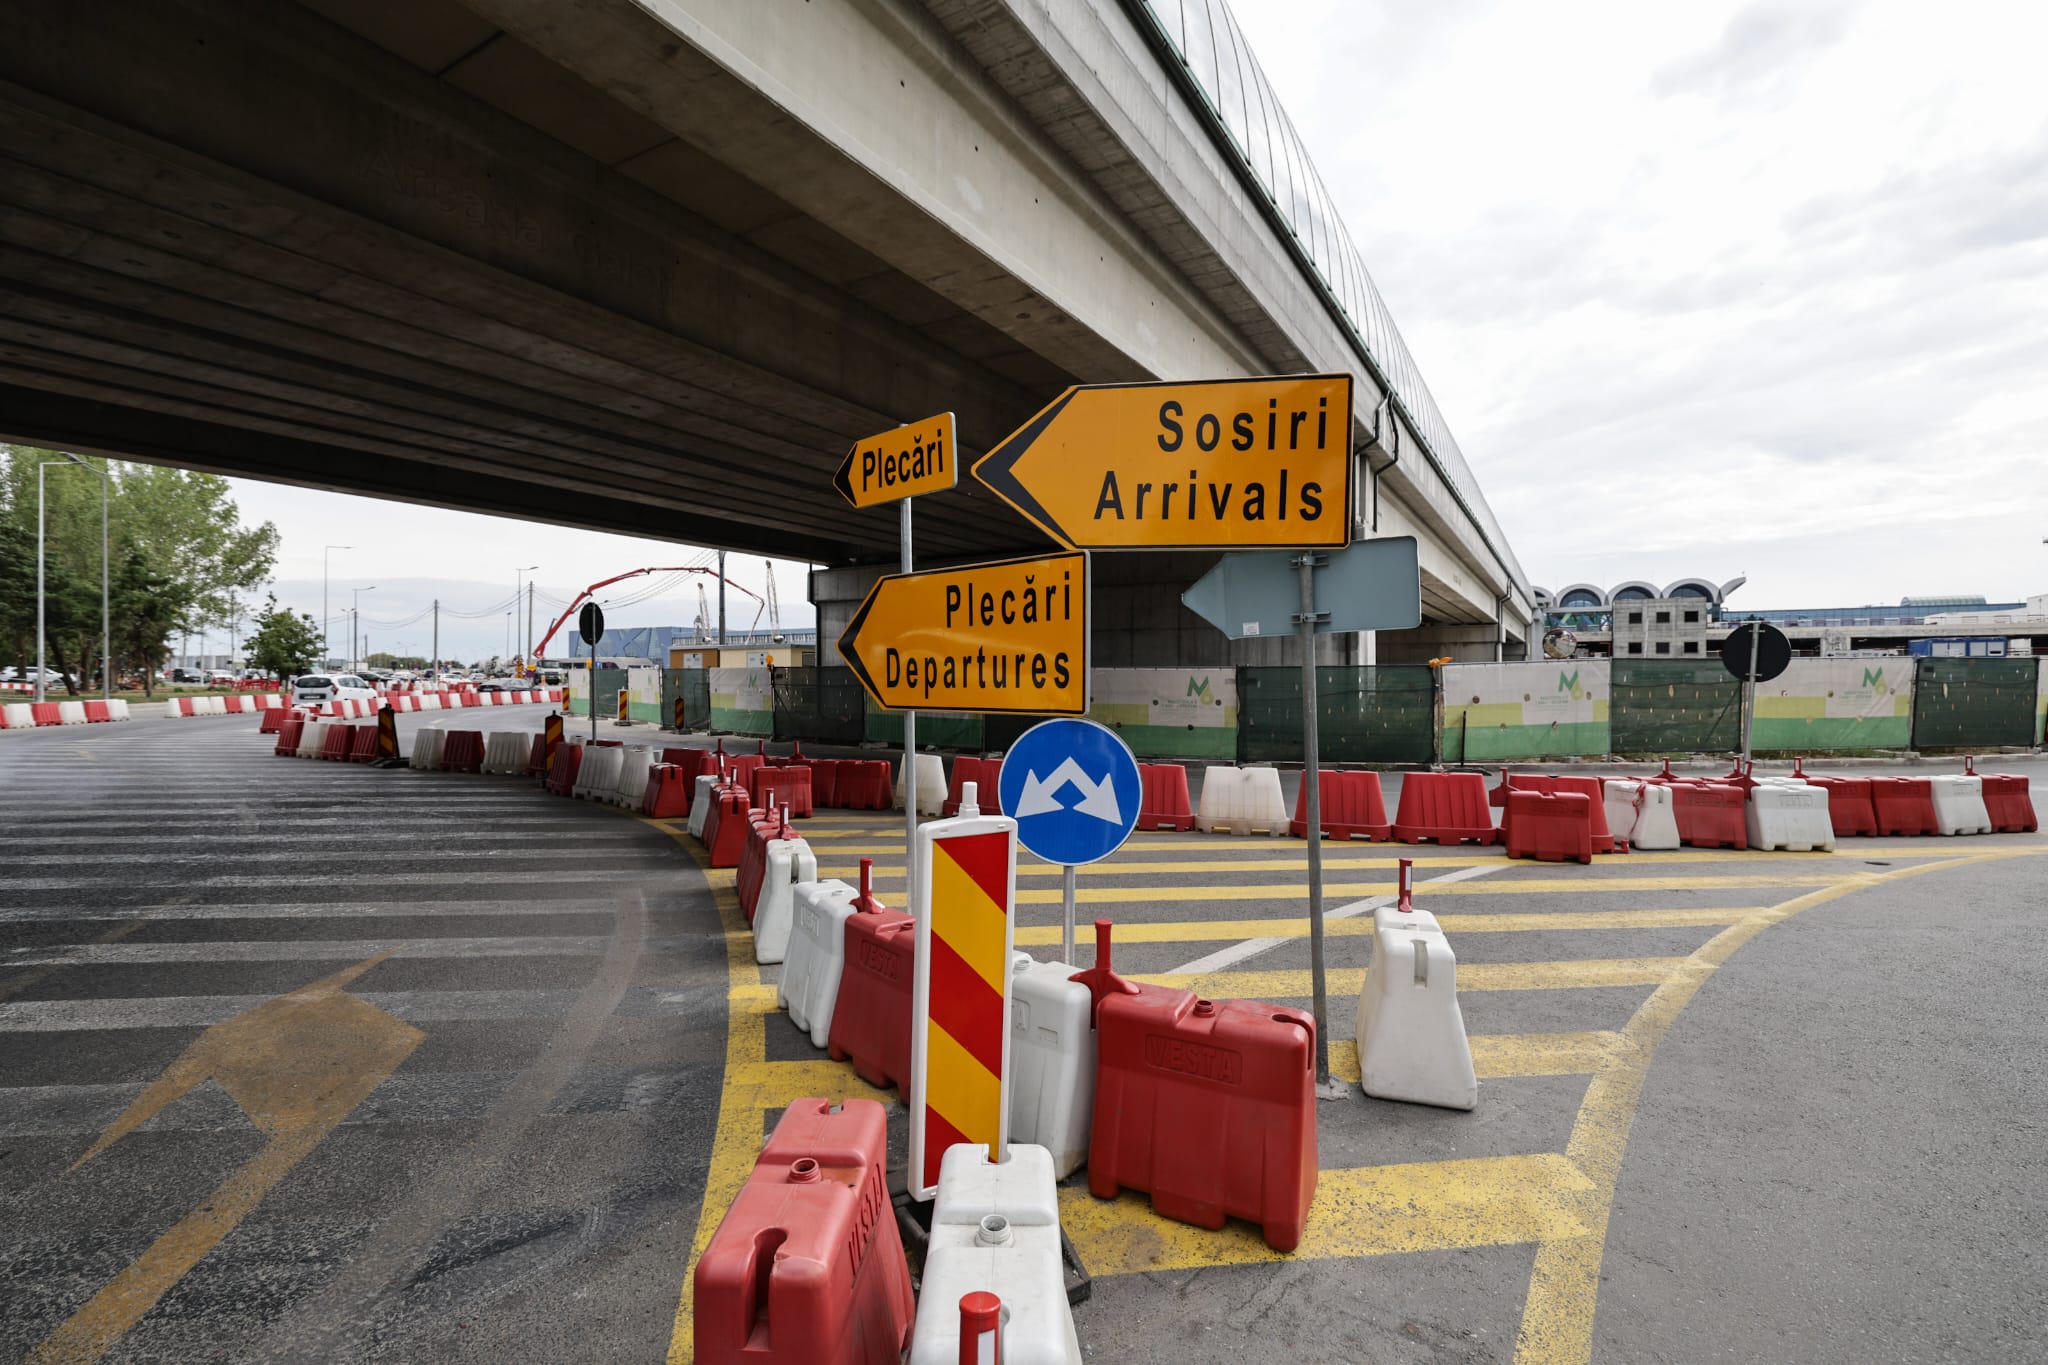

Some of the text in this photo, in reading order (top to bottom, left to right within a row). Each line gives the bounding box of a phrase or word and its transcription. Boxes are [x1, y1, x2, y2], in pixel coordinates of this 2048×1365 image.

[1157, 396, 1328, 453] Sosiri
[862, 428, 944, 493] Plecări
[1093, 468, 1323, 522] Arrivals
[945, 570, 1070, 629] Plecări
[886, 645, 1070, 700] Departures
[1150, 1038, 1236, 1082] VESTA
